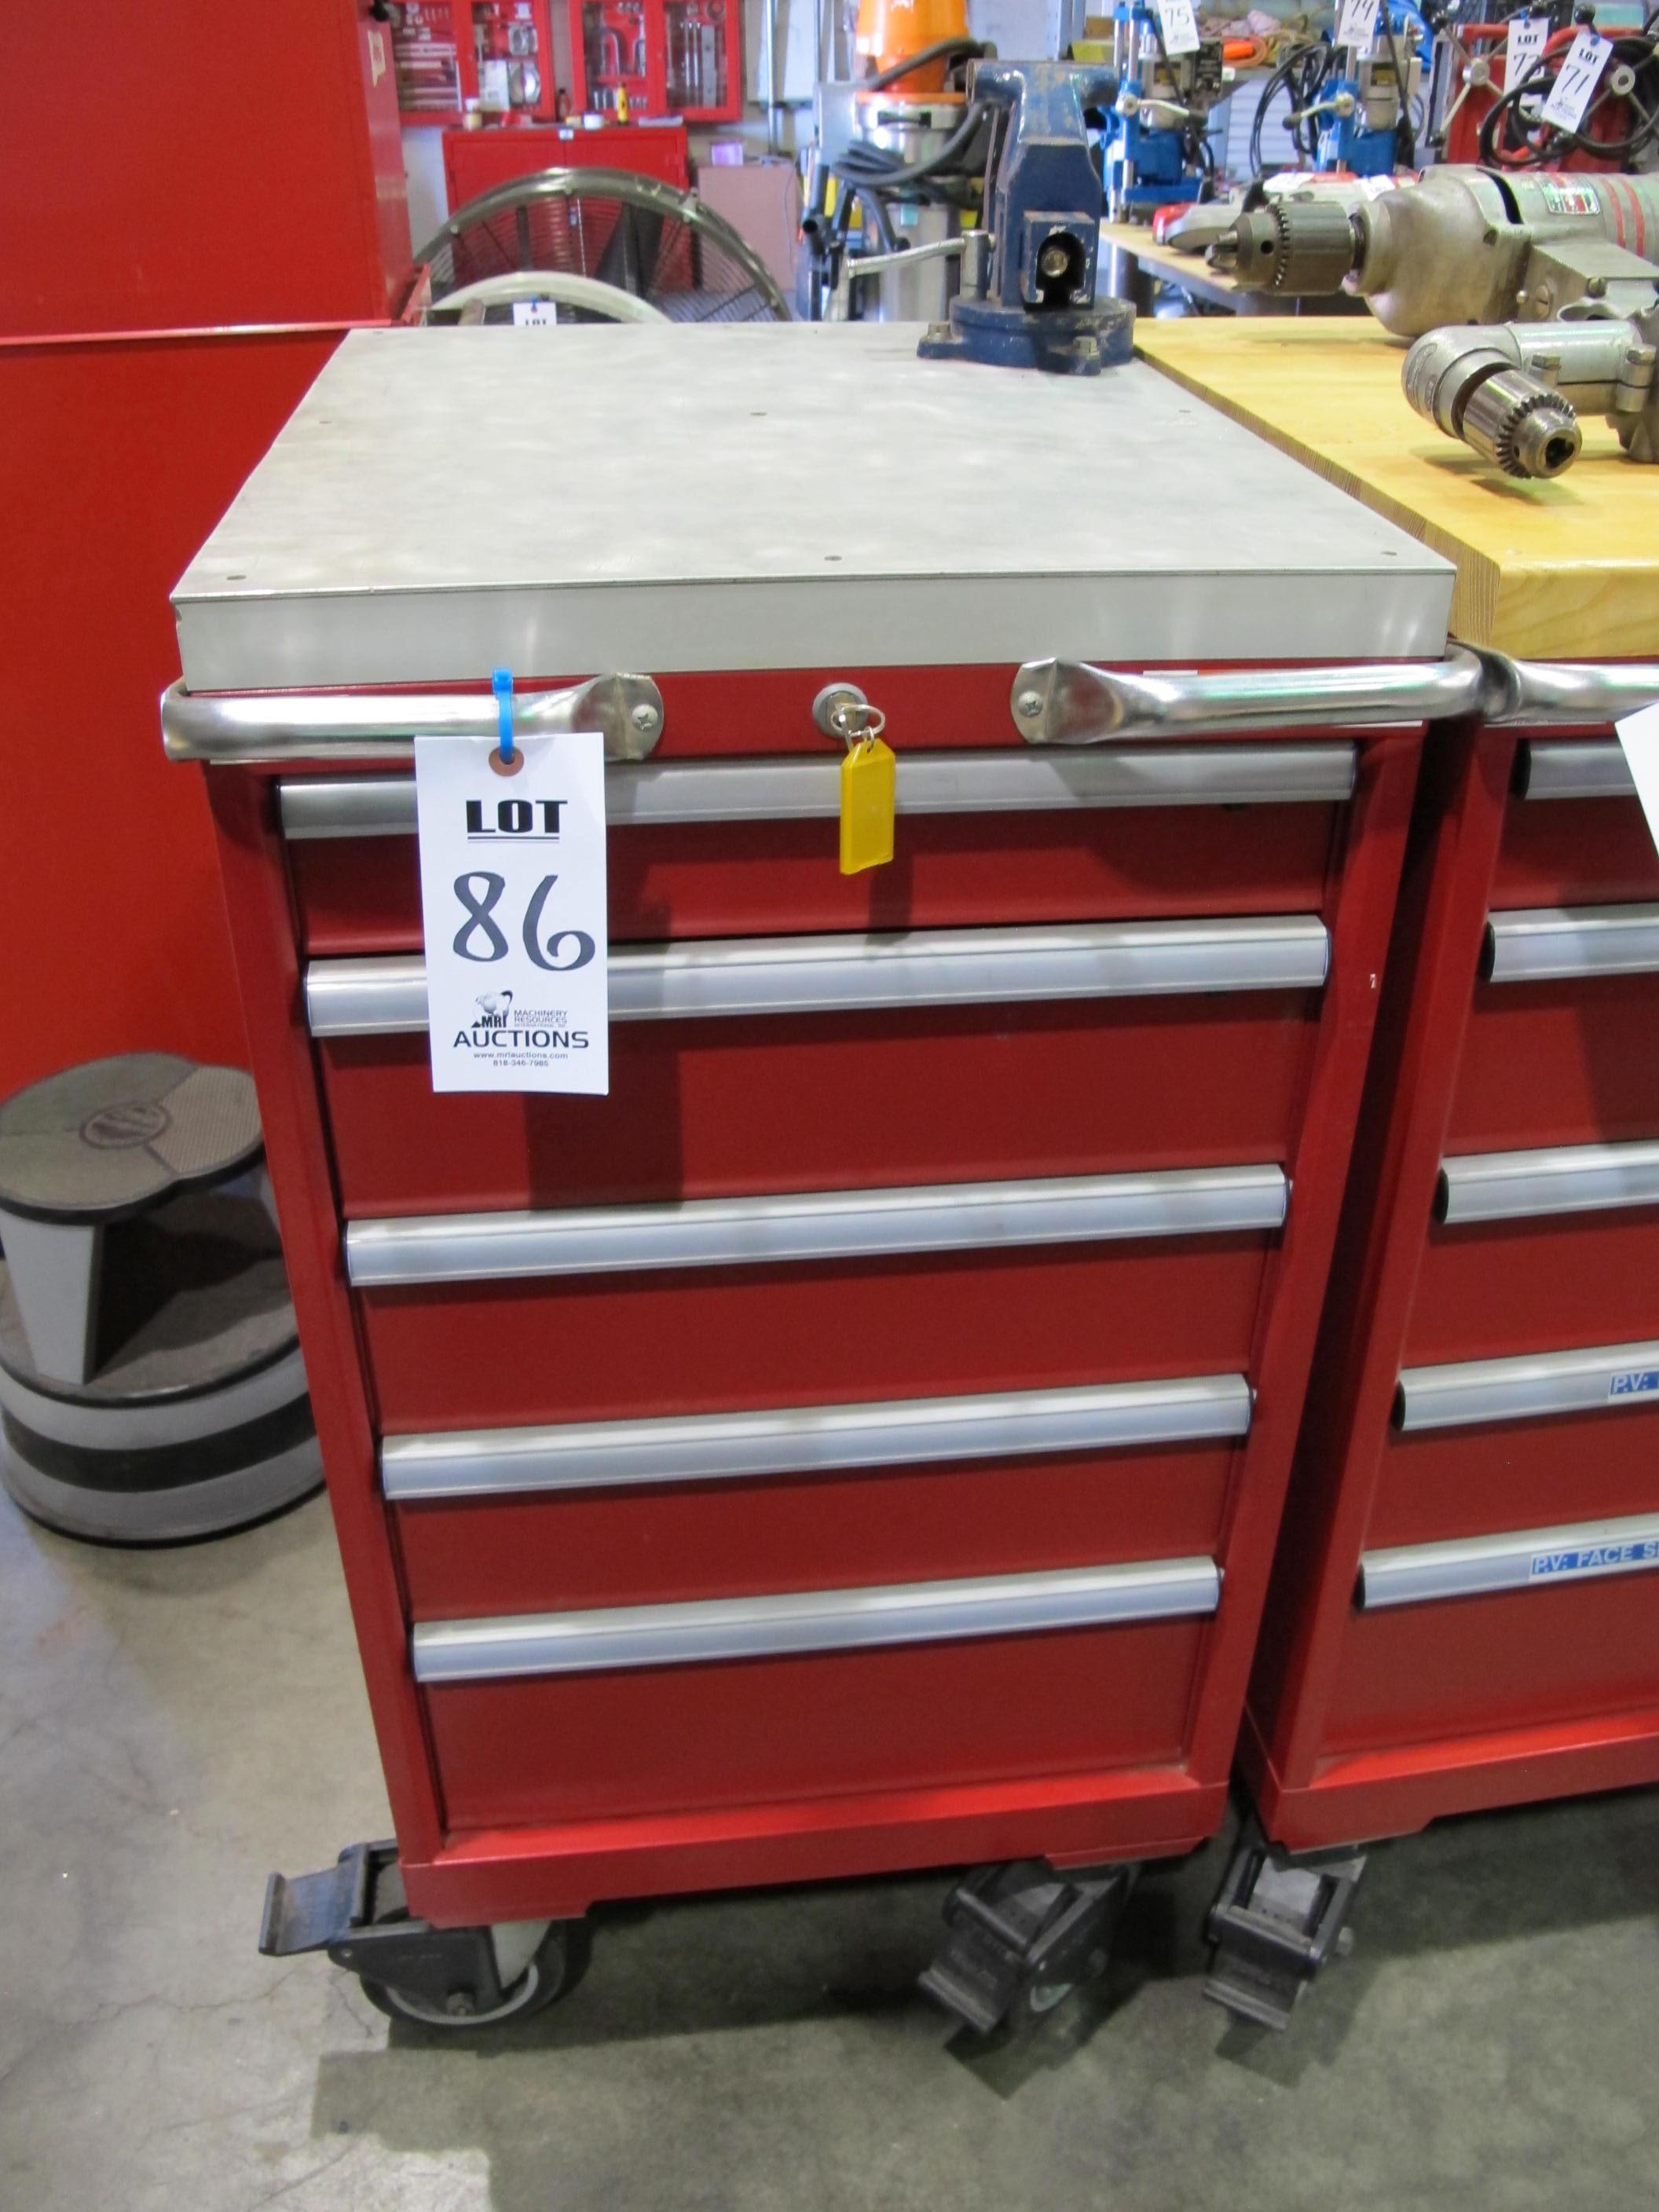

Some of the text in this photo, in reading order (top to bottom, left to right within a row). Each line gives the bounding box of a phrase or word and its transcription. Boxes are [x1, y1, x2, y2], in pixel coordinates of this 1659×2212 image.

[1165, 6, 1190, 27] 75
[1518, 35, 1539, 44] LOT
[1579, 48, 1599, 65] LOT
[1562, 64, 1590, 95] 71
[466, 799, 568, 833] LOT
[452, 871, 596, 971] 86
[453, 1030, 589, 1049] AUCTIONS
[1577, 1545, 1632, 1567] FACE
[1643, 1540, 1659, 1558] S
